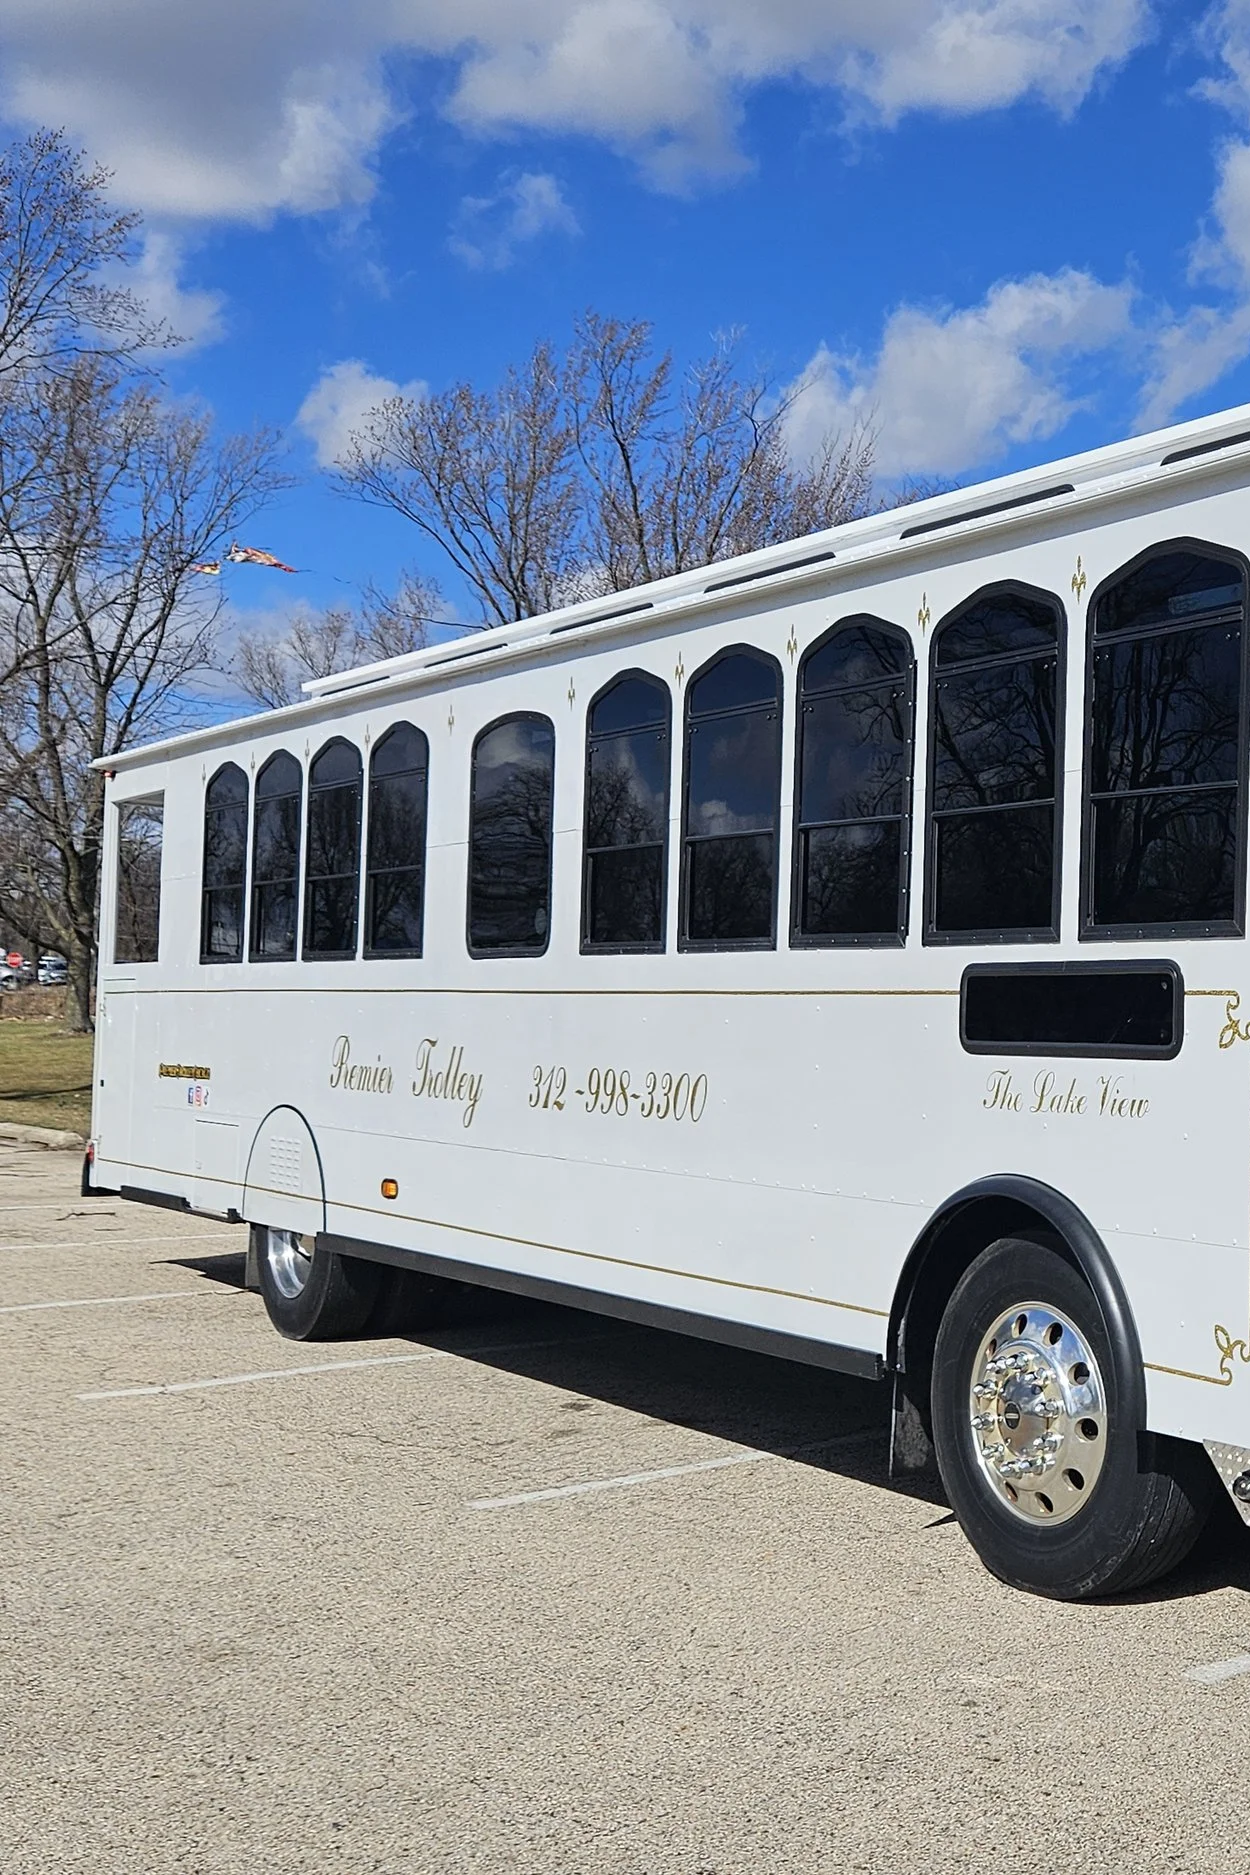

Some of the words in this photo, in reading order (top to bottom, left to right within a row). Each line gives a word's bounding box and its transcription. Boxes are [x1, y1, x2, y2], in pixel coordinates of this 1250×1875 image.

[331, 1035, 394, 1094] Premier
[412, 1038, 483, 1128] Trolley
[528, 1065, 708, 1122] 312-998-3300
[983, 1068, 1023, 1112] The
[1030, 1069, 1087, 1114] Lake
[1097, 1075, 1150, 1118] View
